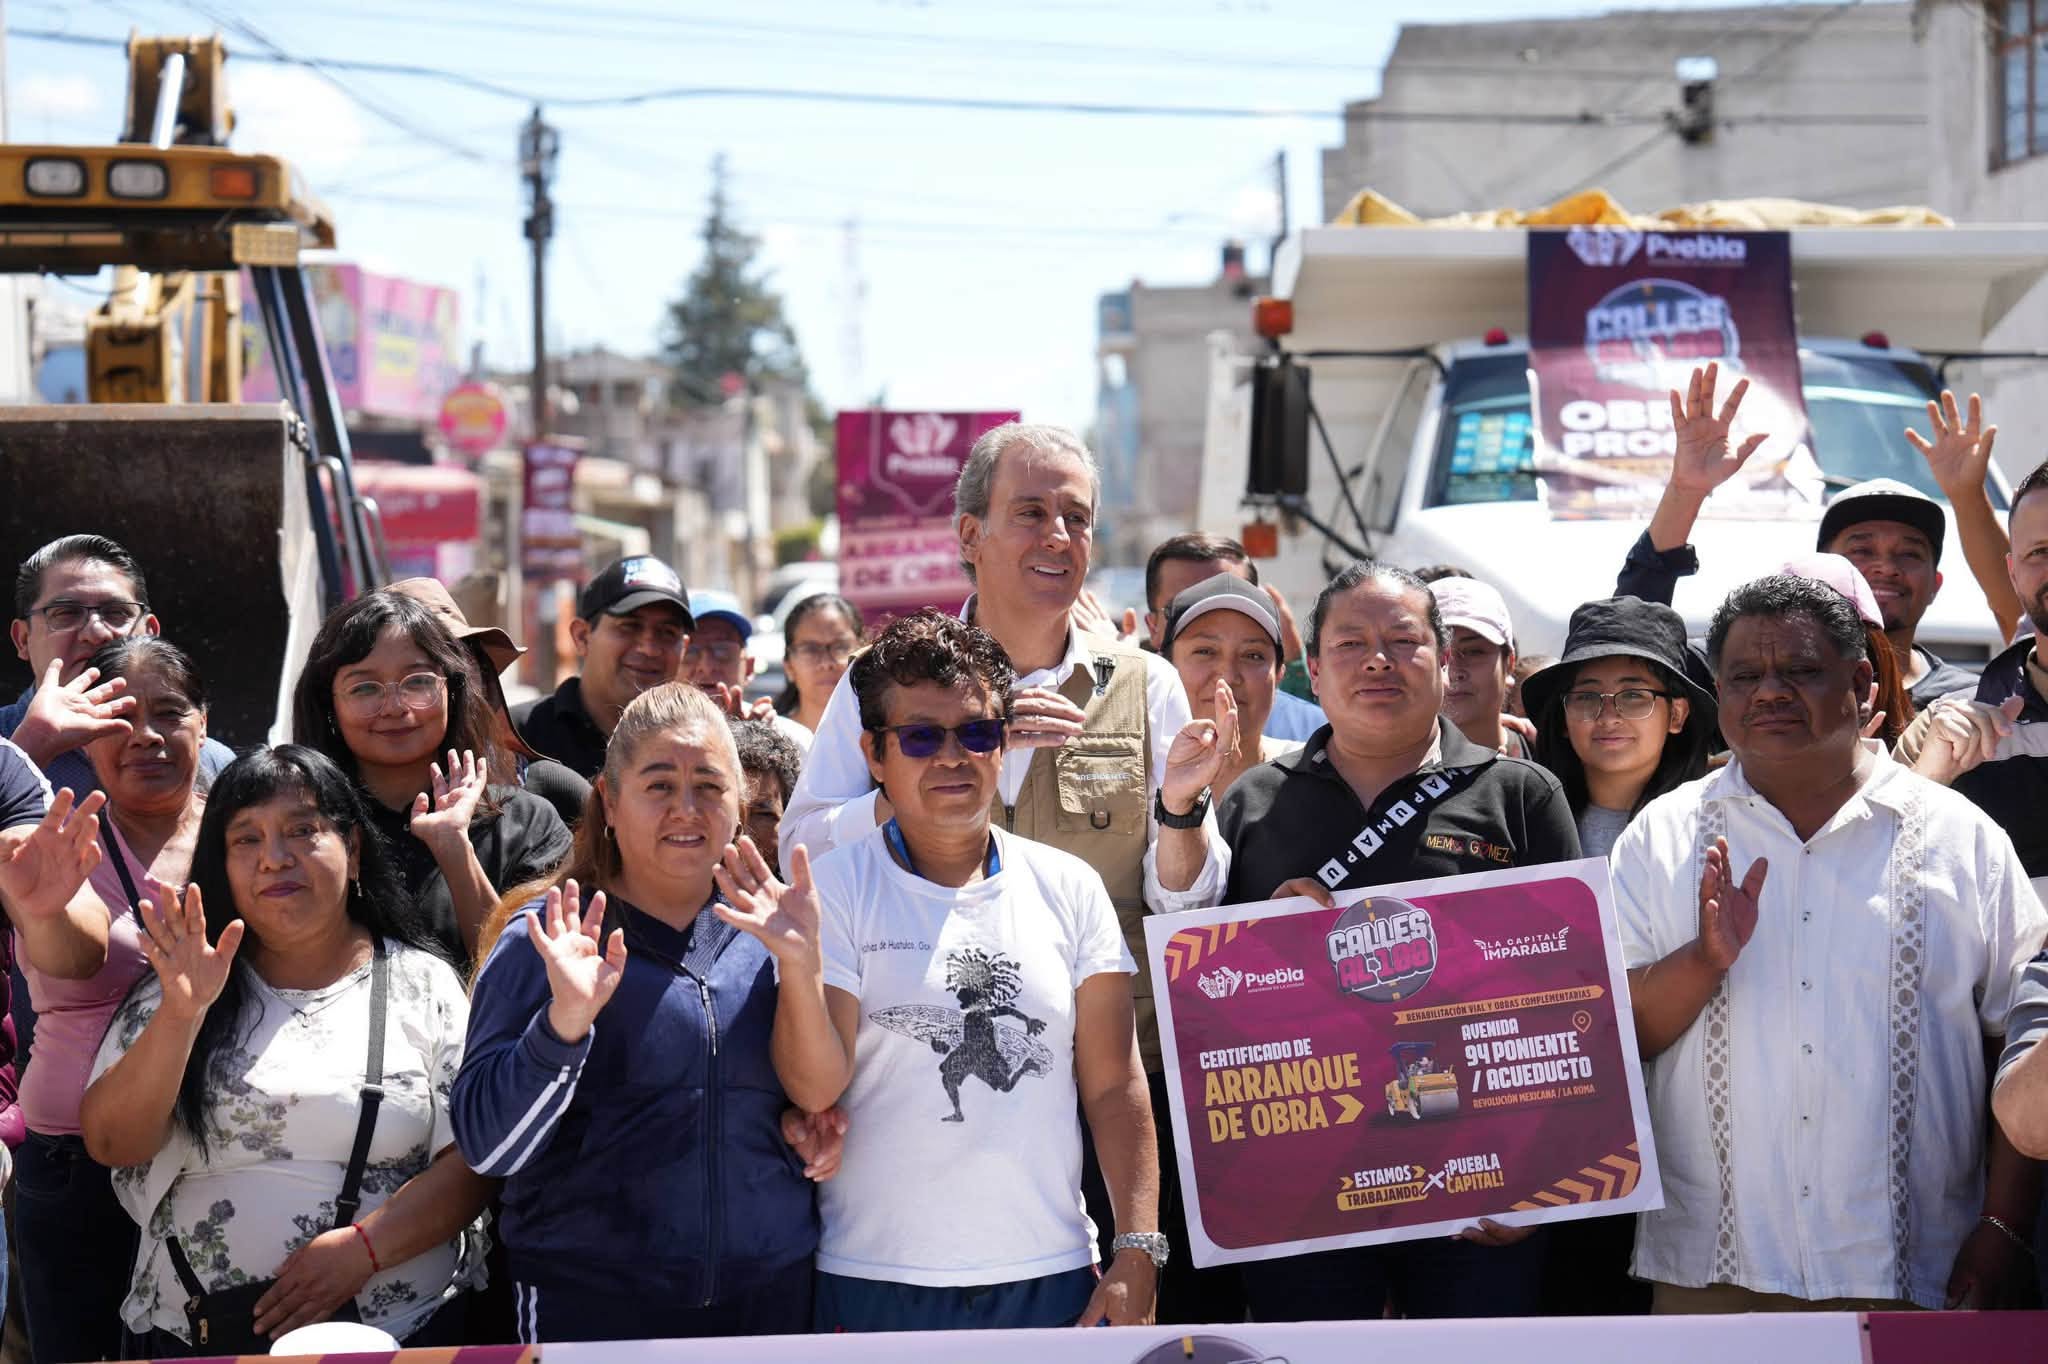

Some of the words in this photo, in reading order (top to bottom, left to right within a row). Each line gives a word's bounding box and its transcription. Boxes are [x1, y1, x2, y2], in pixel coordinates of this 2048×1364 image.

[1646, 233, 1747, 260] Puebla
[1586, 297, 1725, 341] CALLES
[1327, 909, 1429, 962] CALLES
[1483, 939, 1568, 961] IMPARABLE
[1487, 940, 1502, 949] LA
[1507, 932, 1559, 946] CAPITAL
[1245, 967, 1305, 988] Puebla
[1338, 953, 1374, 988] AL
[1374, 938, 1431, 978] 100
[1405, 1005, 1467, 1022] REHABILITACIÓN
[1468, 1003, 1485, 1013] VIAL
[1487, 1002, 1493, 1010] Y
[1494, 999, 1520, 1010] OBRAS
[1520, 989, 1592, 1006] COMPLEMENTARIAS
[1461, 1018, 1519, 1041] AVENIDA
[1199, 1040, 1293, 1070] CERTIFICADO
[1293, 1037, 1313, 1056] DE
[1465, 1042, 1491, 1067] 94
[1491, 1031, 1580, 1063] PONIENTE
[1205, 1052, 1362, 1107] ARRANQUE
[1472, 1070, 1482, 1093] /
[1486, 1056, 1593, 1091] ACUEDUCTO
[1519, 1088, 1557, 1104] MEXICANA
[1562, 1087, 1573, 1097] LA
[1573, 1084, 1596, 1096] ROMA
[1207, 1106, 1247, 1143] DE
[1250, 1096, 1329, 1137] OBRA
[1354, 1164, 1413, 1188] ESTAMOS
[1444, 1152, 1501, 1180] ¡PUEBLA
[1345, 1184, 1420, 1207] TRABAJANDO
[1446, 1170, 1505, 1194] CAPITAL!
